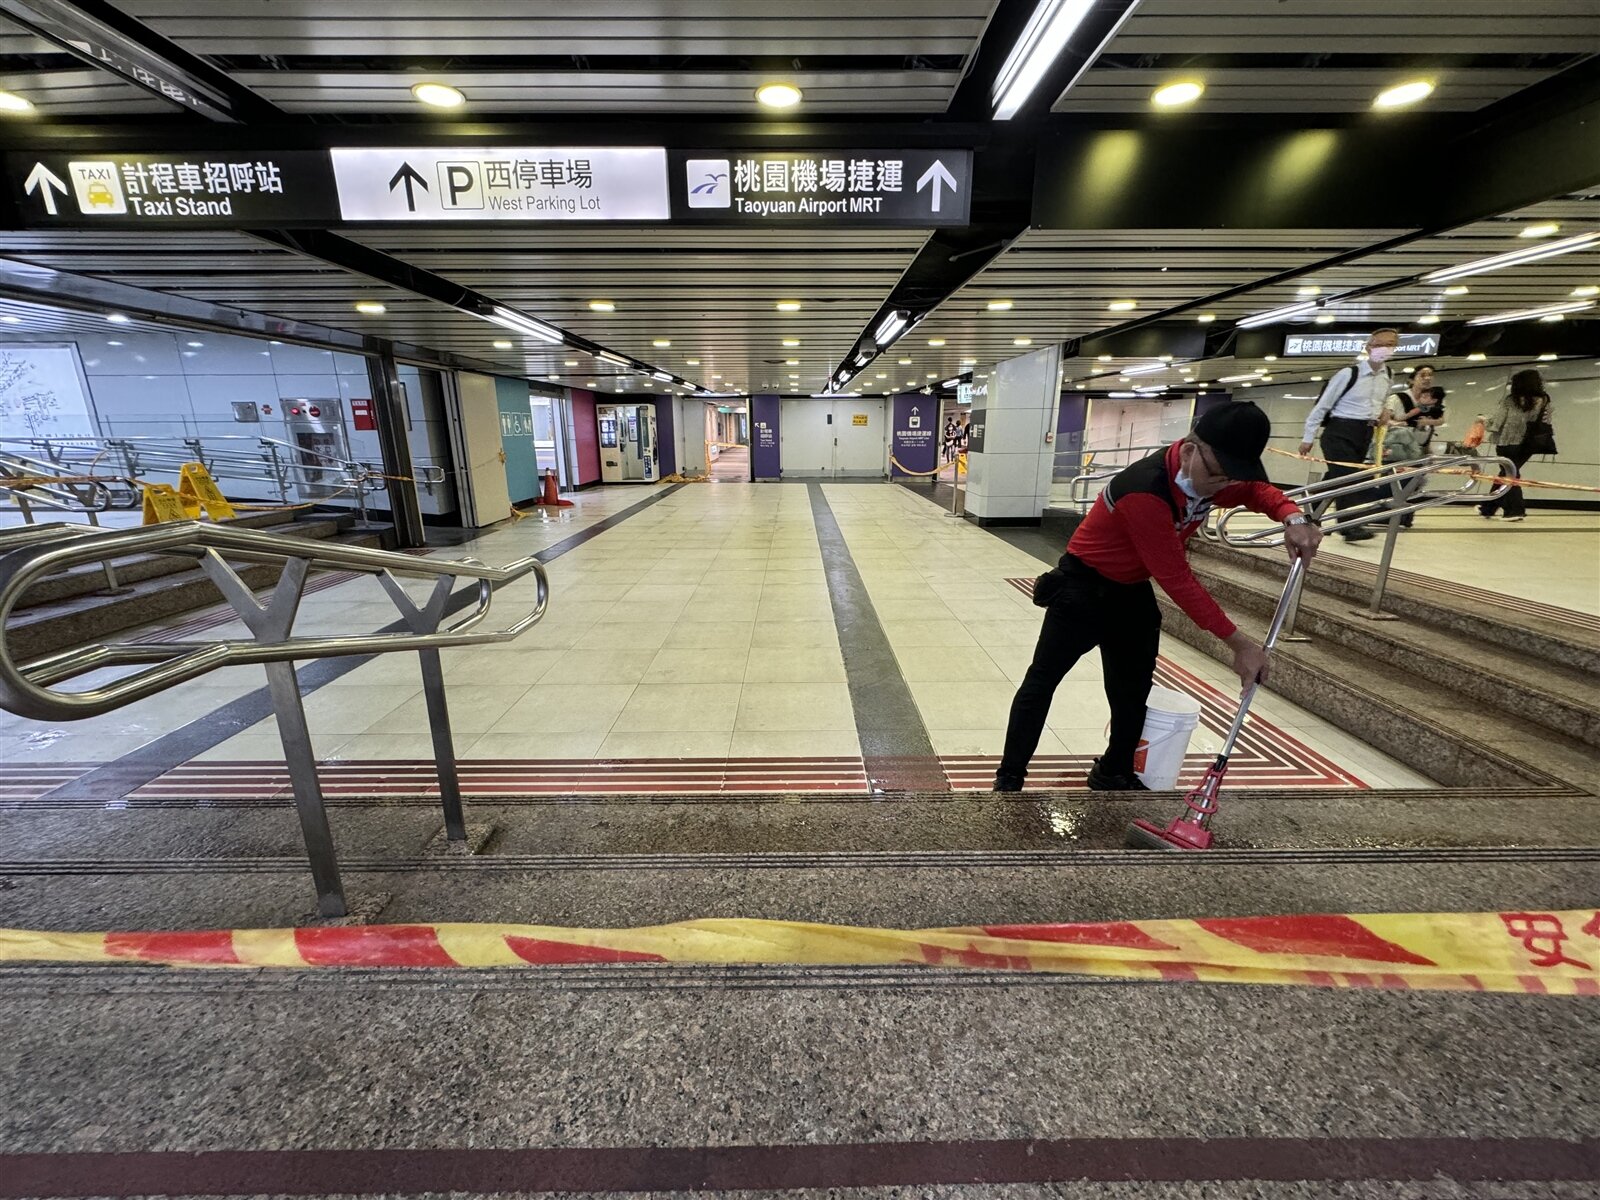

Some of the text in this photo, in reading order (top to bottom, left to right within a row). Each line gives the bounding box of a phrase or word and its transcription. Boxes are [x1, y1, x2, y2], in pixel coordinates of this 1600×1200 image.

[78, 168, 111, 181] TAXI
[121, 161, 283, 195] 計程車招呼站
[484, 159, 593, 190] 西停車場
[734, 159, 903, 193] 桃園機場捷運
[128, 197, 233, 216] Taxi Stand
[488, 195, 601, 214] West Parking Lot
[735, 198, 883, 216] Taoyuan Airport MRT
[1498, 910, 1600, 971] 安
